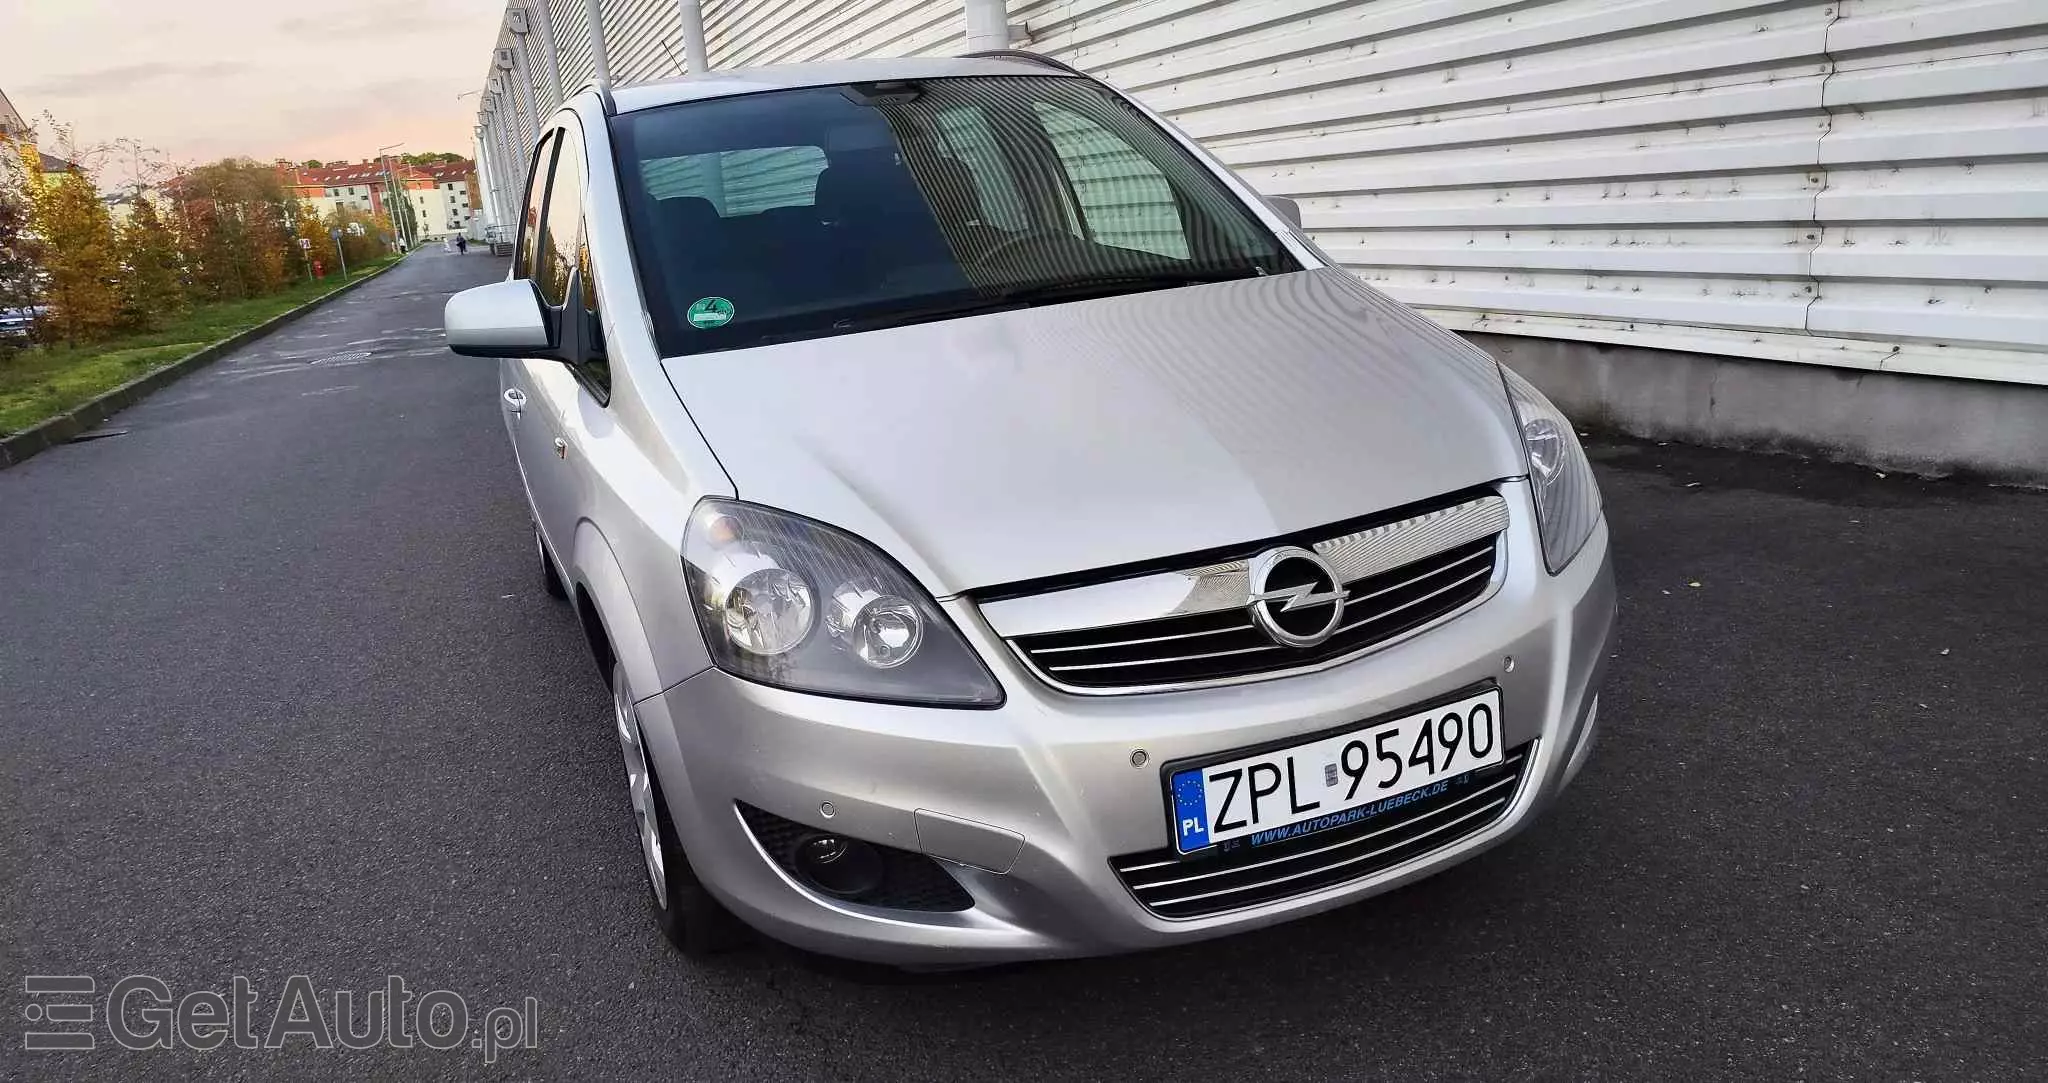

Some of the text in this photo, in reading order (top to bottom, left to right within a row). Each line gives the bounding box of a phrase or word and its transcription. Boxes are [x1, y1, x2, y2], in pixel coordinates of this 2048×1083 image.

[704, 299, 718, 314] 4
[1208, 703, 1494, 834] ZPL 95490
[1182, 817, 1205, 837] PL
[1251, 781, 1449, 846] WWW.AUTOPARK-LUEBECK.DE
